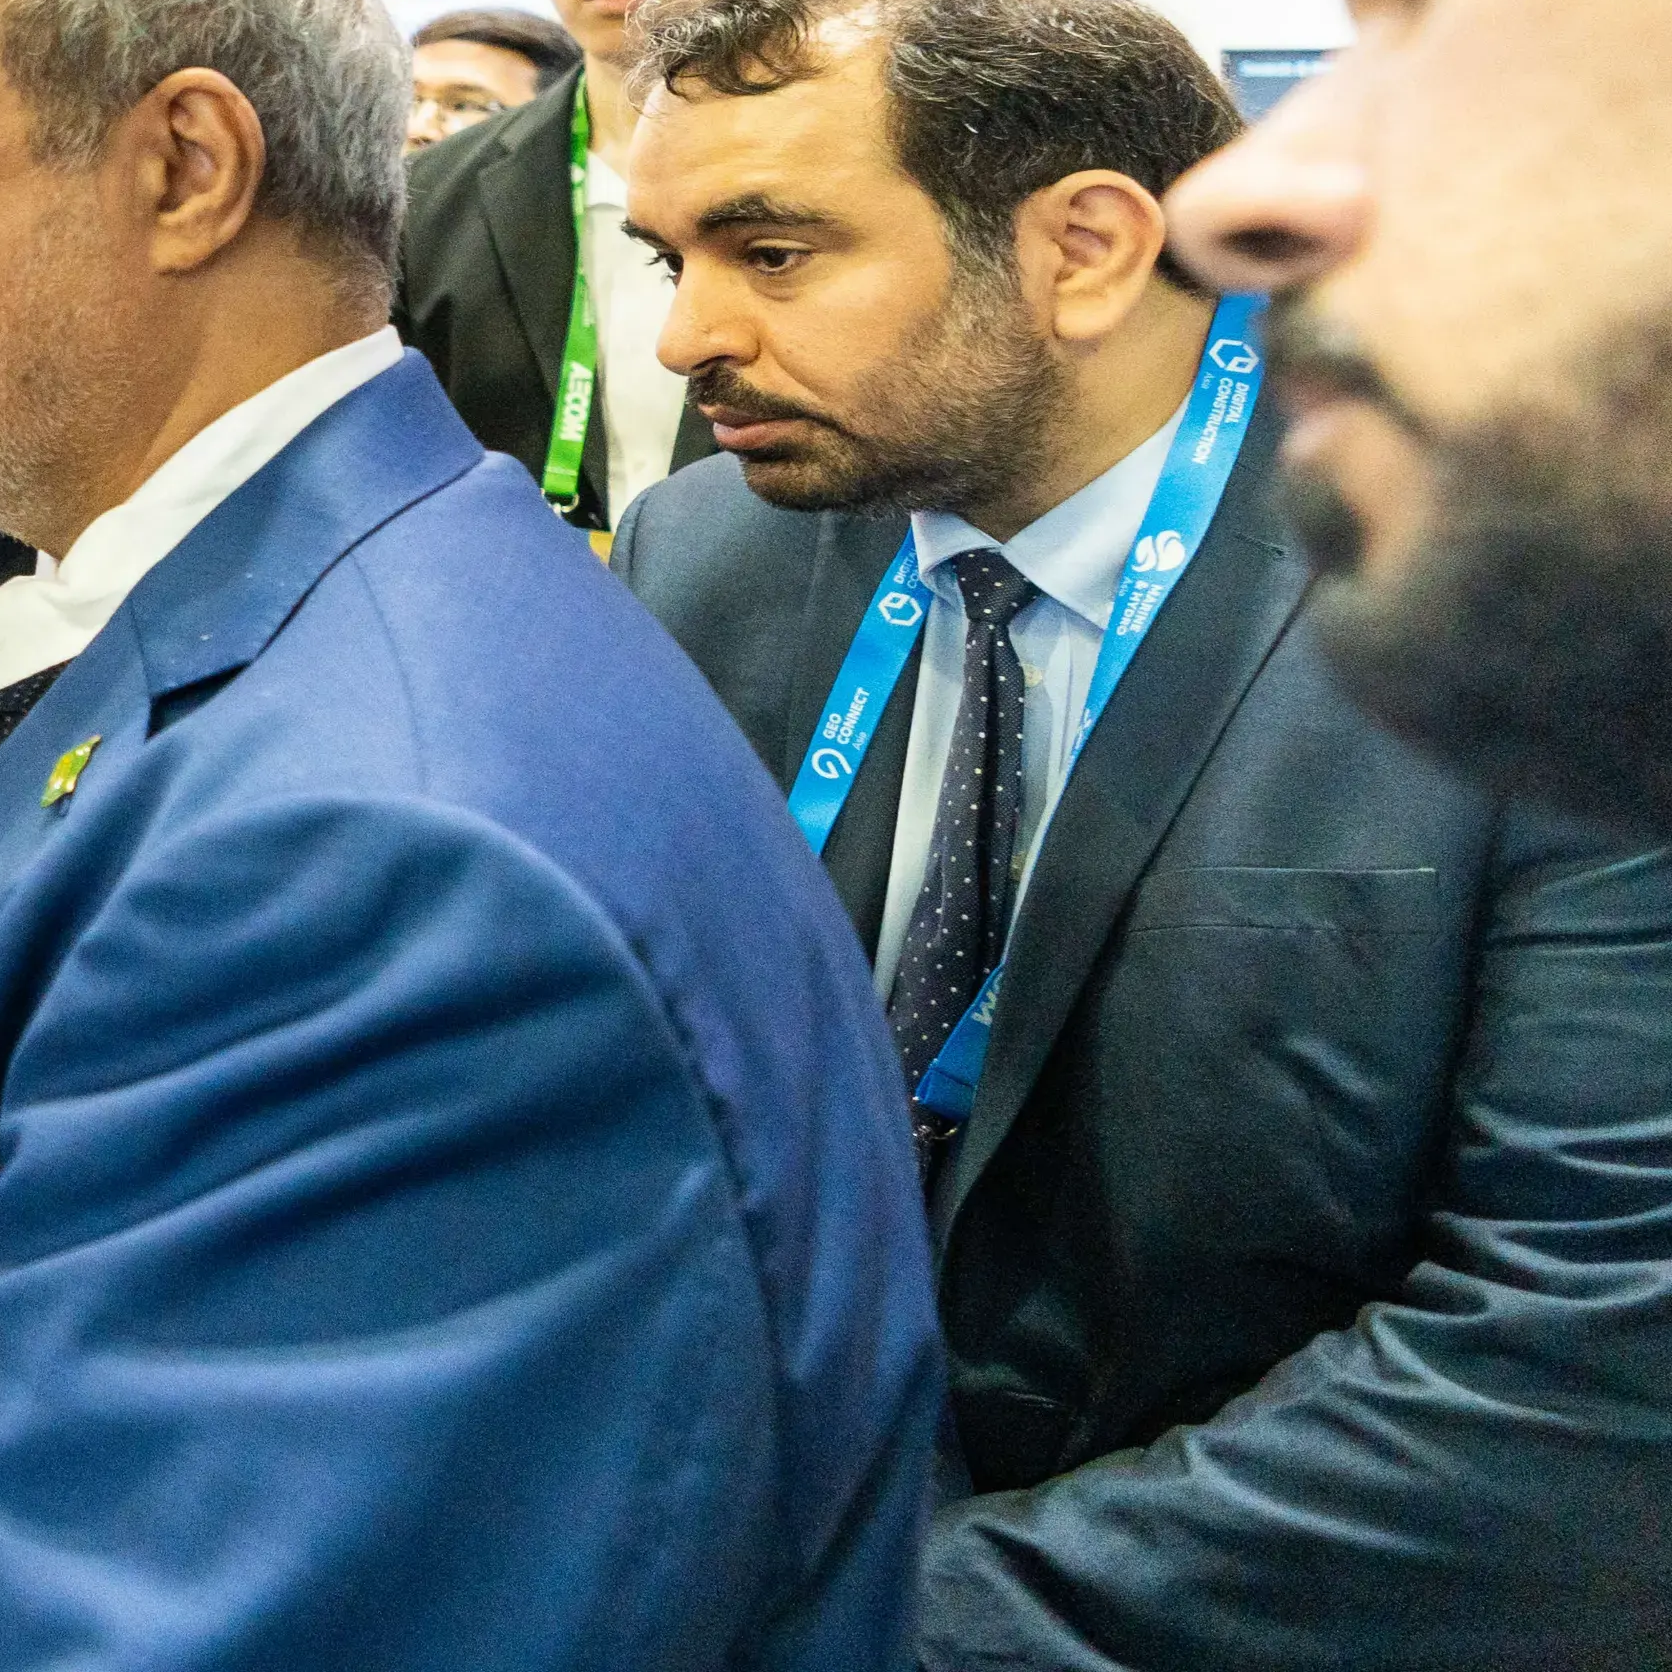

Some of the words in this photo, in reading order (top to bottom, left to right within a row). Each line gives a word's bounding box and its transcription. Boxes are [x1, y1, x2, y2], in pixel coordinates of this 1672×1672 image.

[559, 360, 593, 443] AECOM
[1192, 377, 1234, 465] CONSTRUCTION
[1224, 381, 1250, 424] DIGITAL
[1116, 592, 1144, 637] HYDRO
[1130, 582, 1165, 635] MARINE
[822, 713, 843, 740] GEO
[836, 686, 870, 746] CONNECT
